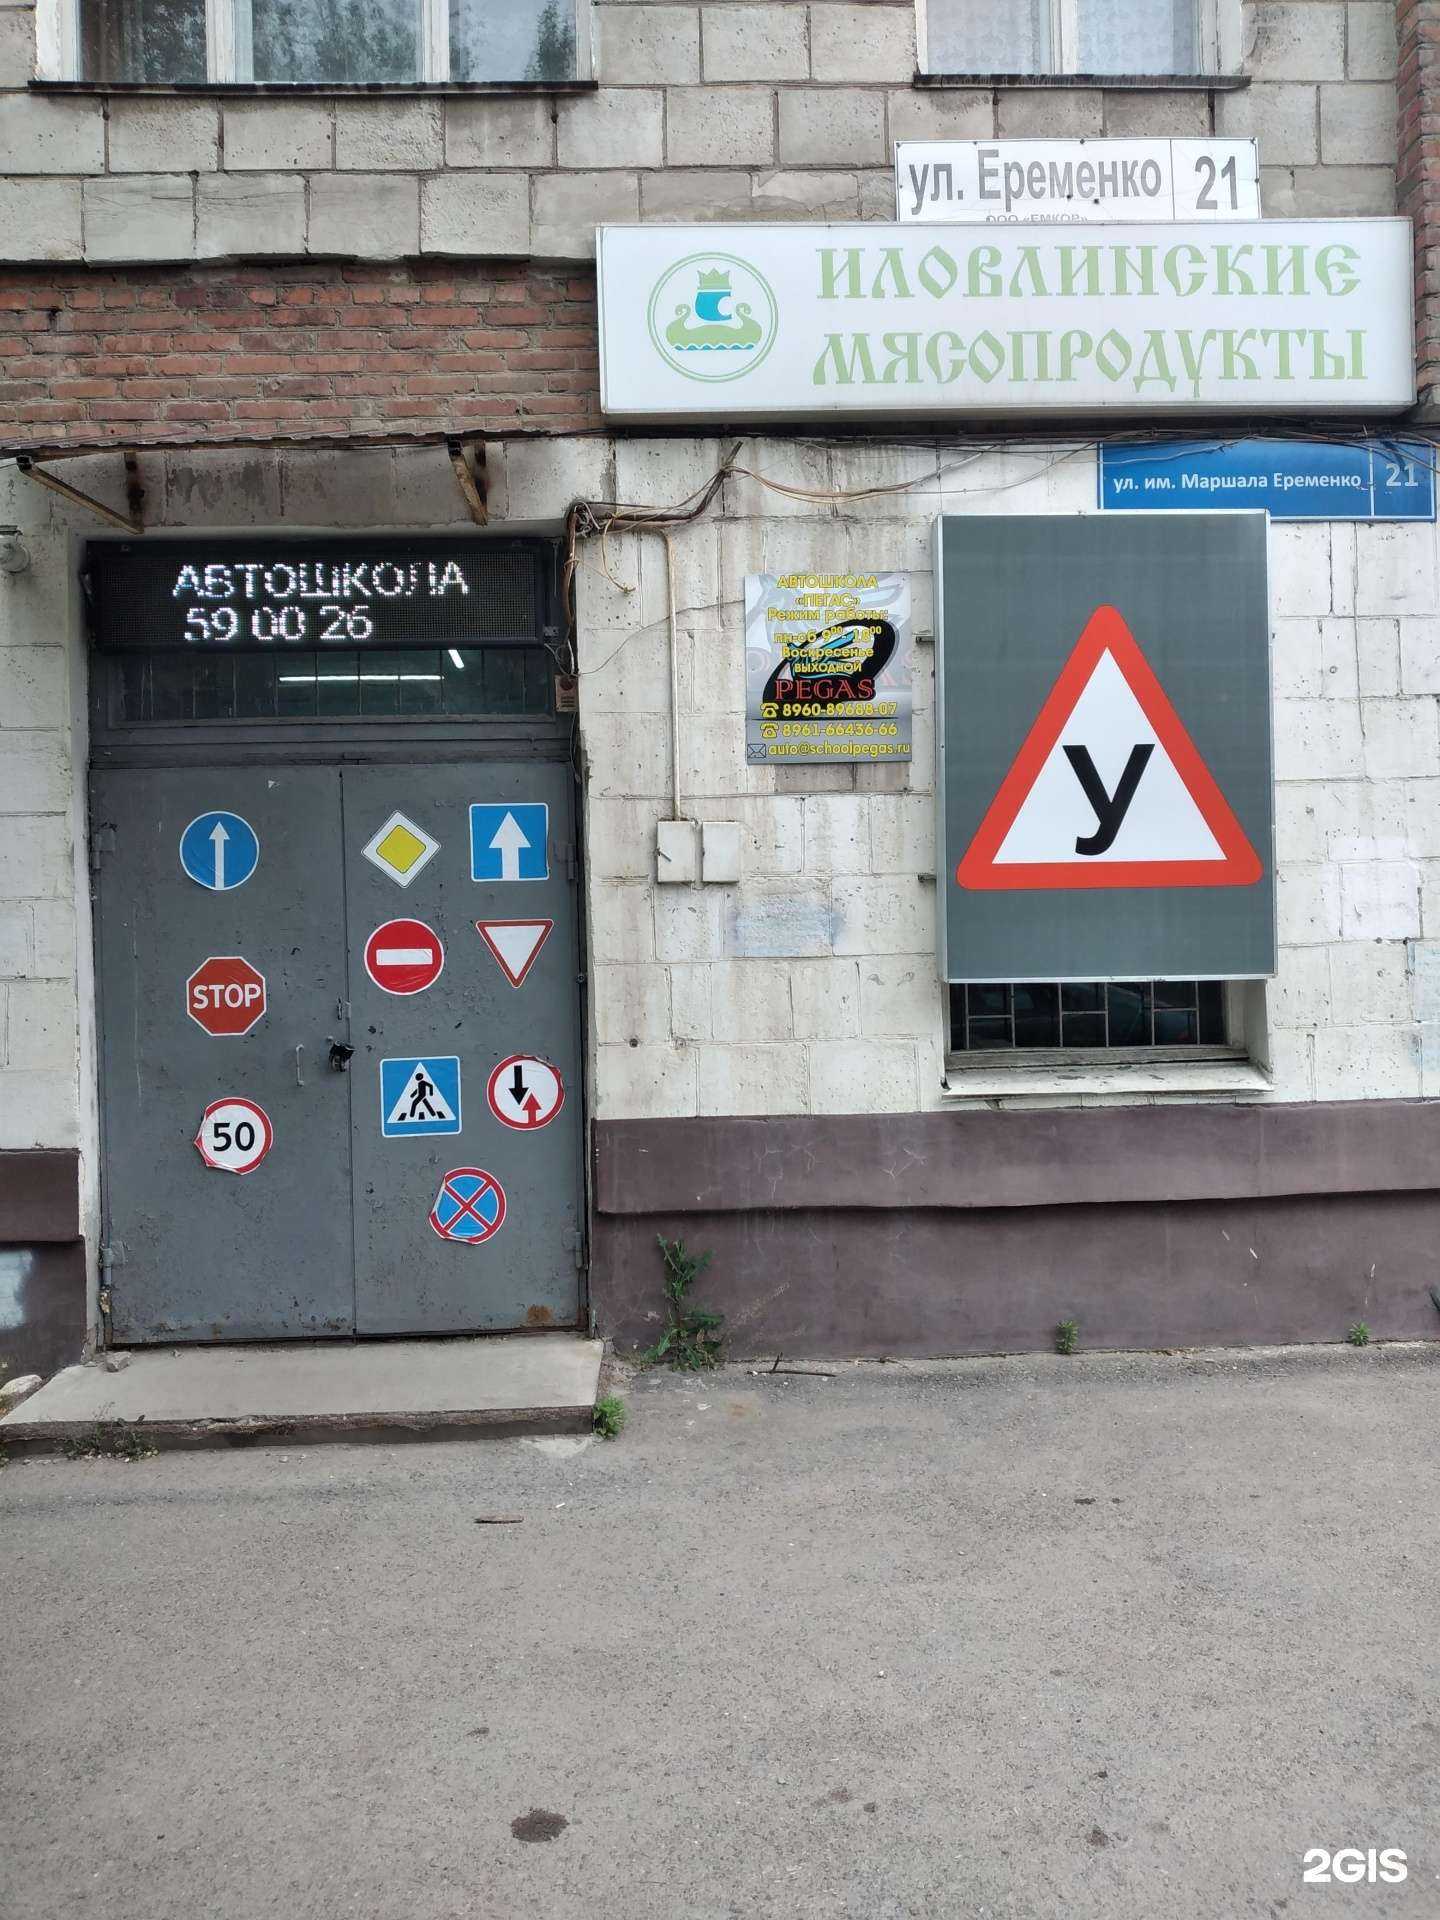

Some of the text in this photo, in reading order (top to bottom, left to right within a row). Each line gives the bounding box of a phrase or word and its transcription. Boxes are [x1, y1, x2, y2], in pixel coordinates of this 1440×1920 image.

[909, 149, 1238, 215] ул. Еременко 21
[814, 244, 1362, 300] ИЛОВЛИНСКИЕ
[812, 328, 1369, 398] МЯСОПРОДУКТЫ
[1112, 462, 1419, 492] ул. им. Маршала Еременко 21
[171, 561, 471, 598] АВТОШКОЛА
[777, 574, 879, 588] АВТОШКОЛА
[767, 606, 821, 621] Режим
[795, 592, 861, 608] «ПЕГАС»
[183, 605, 374, 641] 59 00 26
[781, 646, 875, 659] Воскресенье
[774, 678, 875, 700] PEGAS
[768, 740, 911, 758] auto@schoolpegas.ru
[192, 984, 262, 1010] STOP
[212, 1122, 256, 1153] 50
